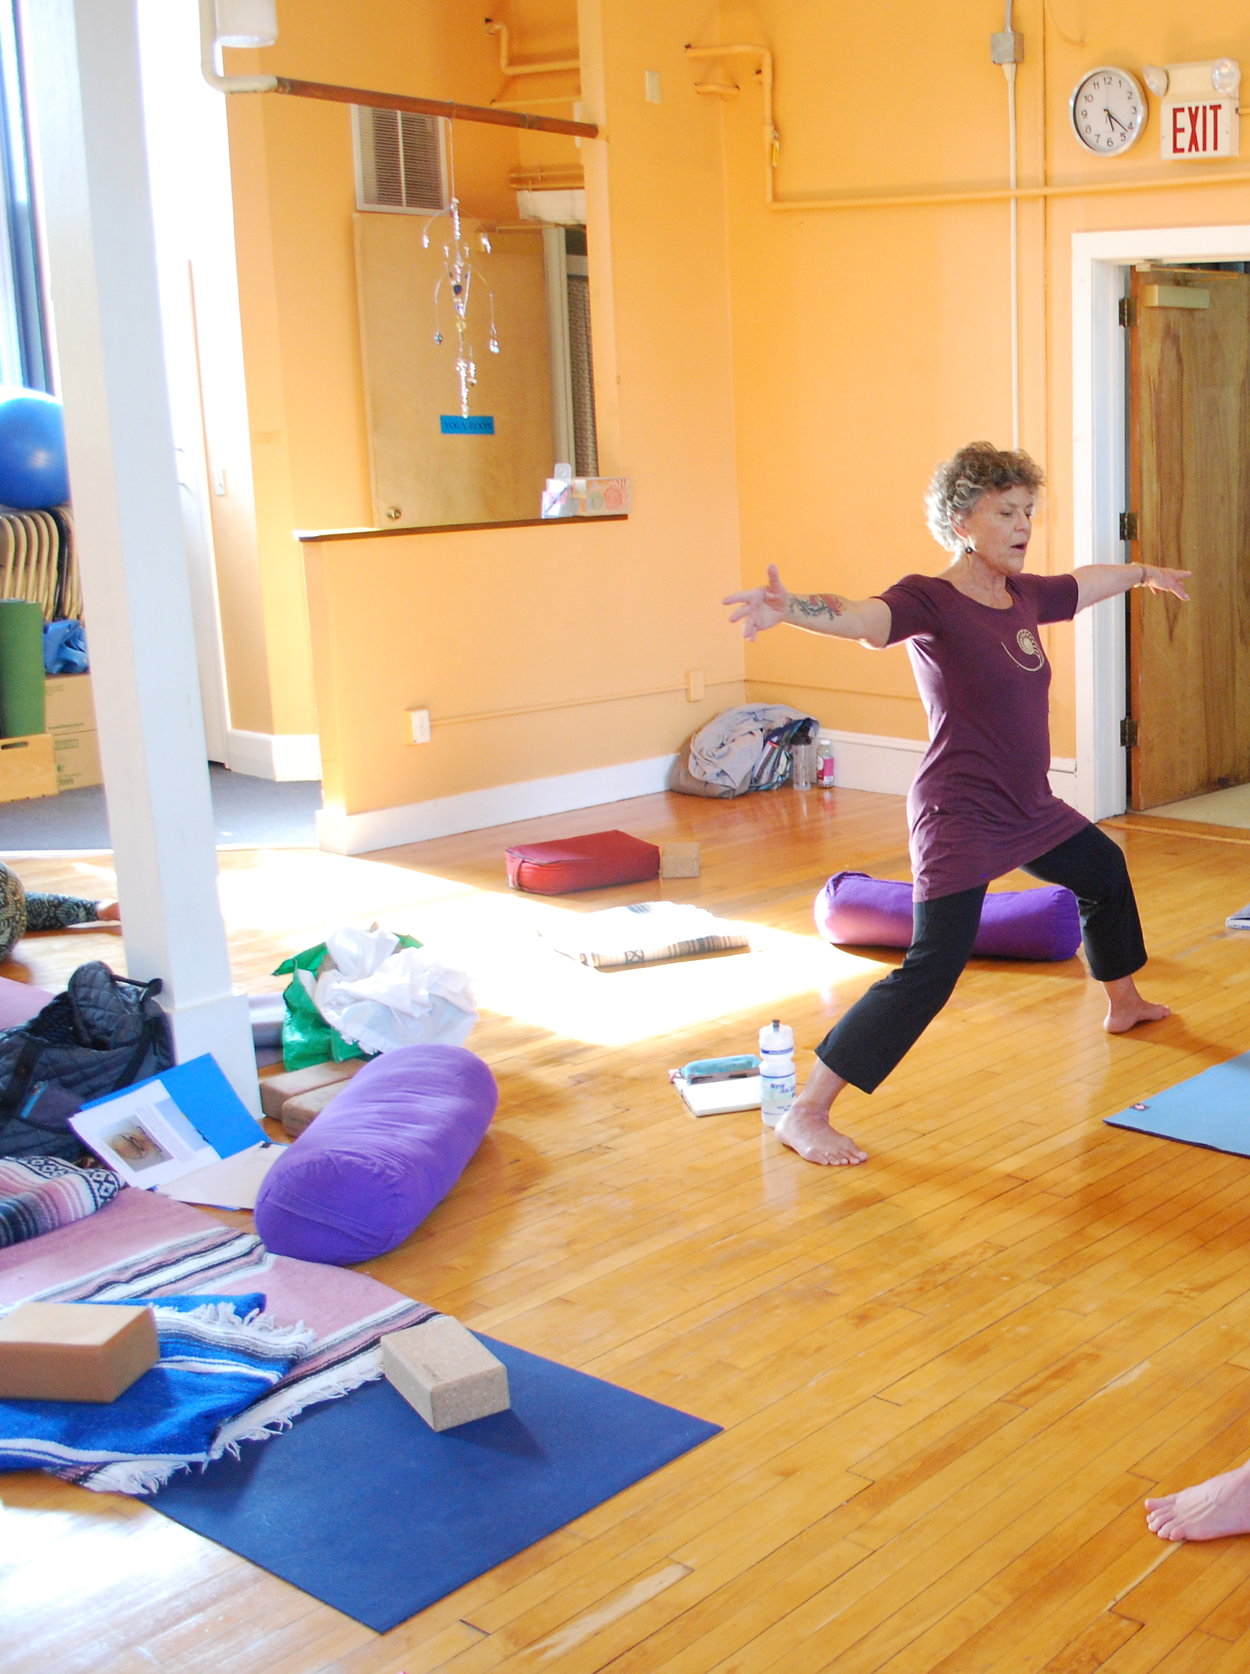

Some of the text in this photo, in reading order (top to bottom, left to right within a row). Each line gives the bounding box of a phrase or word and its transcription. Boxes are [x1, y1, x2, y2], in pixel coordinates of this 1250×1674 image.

[1092, 81, 1100, 90] 11
[1103, 76, 1113, 86] 12
[1118, 79, 1122, 88] 1
[1084, 94, 1094, 103] 10
[1127, 90, 1133, 100] 2
[1081, 109, 1088, 119] 9
[1131, 105, 1138, 115] 3
[1085, 124, 1092, 134] 8
[1127, 121, 1134, 130] 4
[1172, 104, 1222, 154] EXIT
[1095, 133, 1101, 144] 7
[1106, 137, 1114, 147] 6
[1120, 132, 1127, 142] 5
